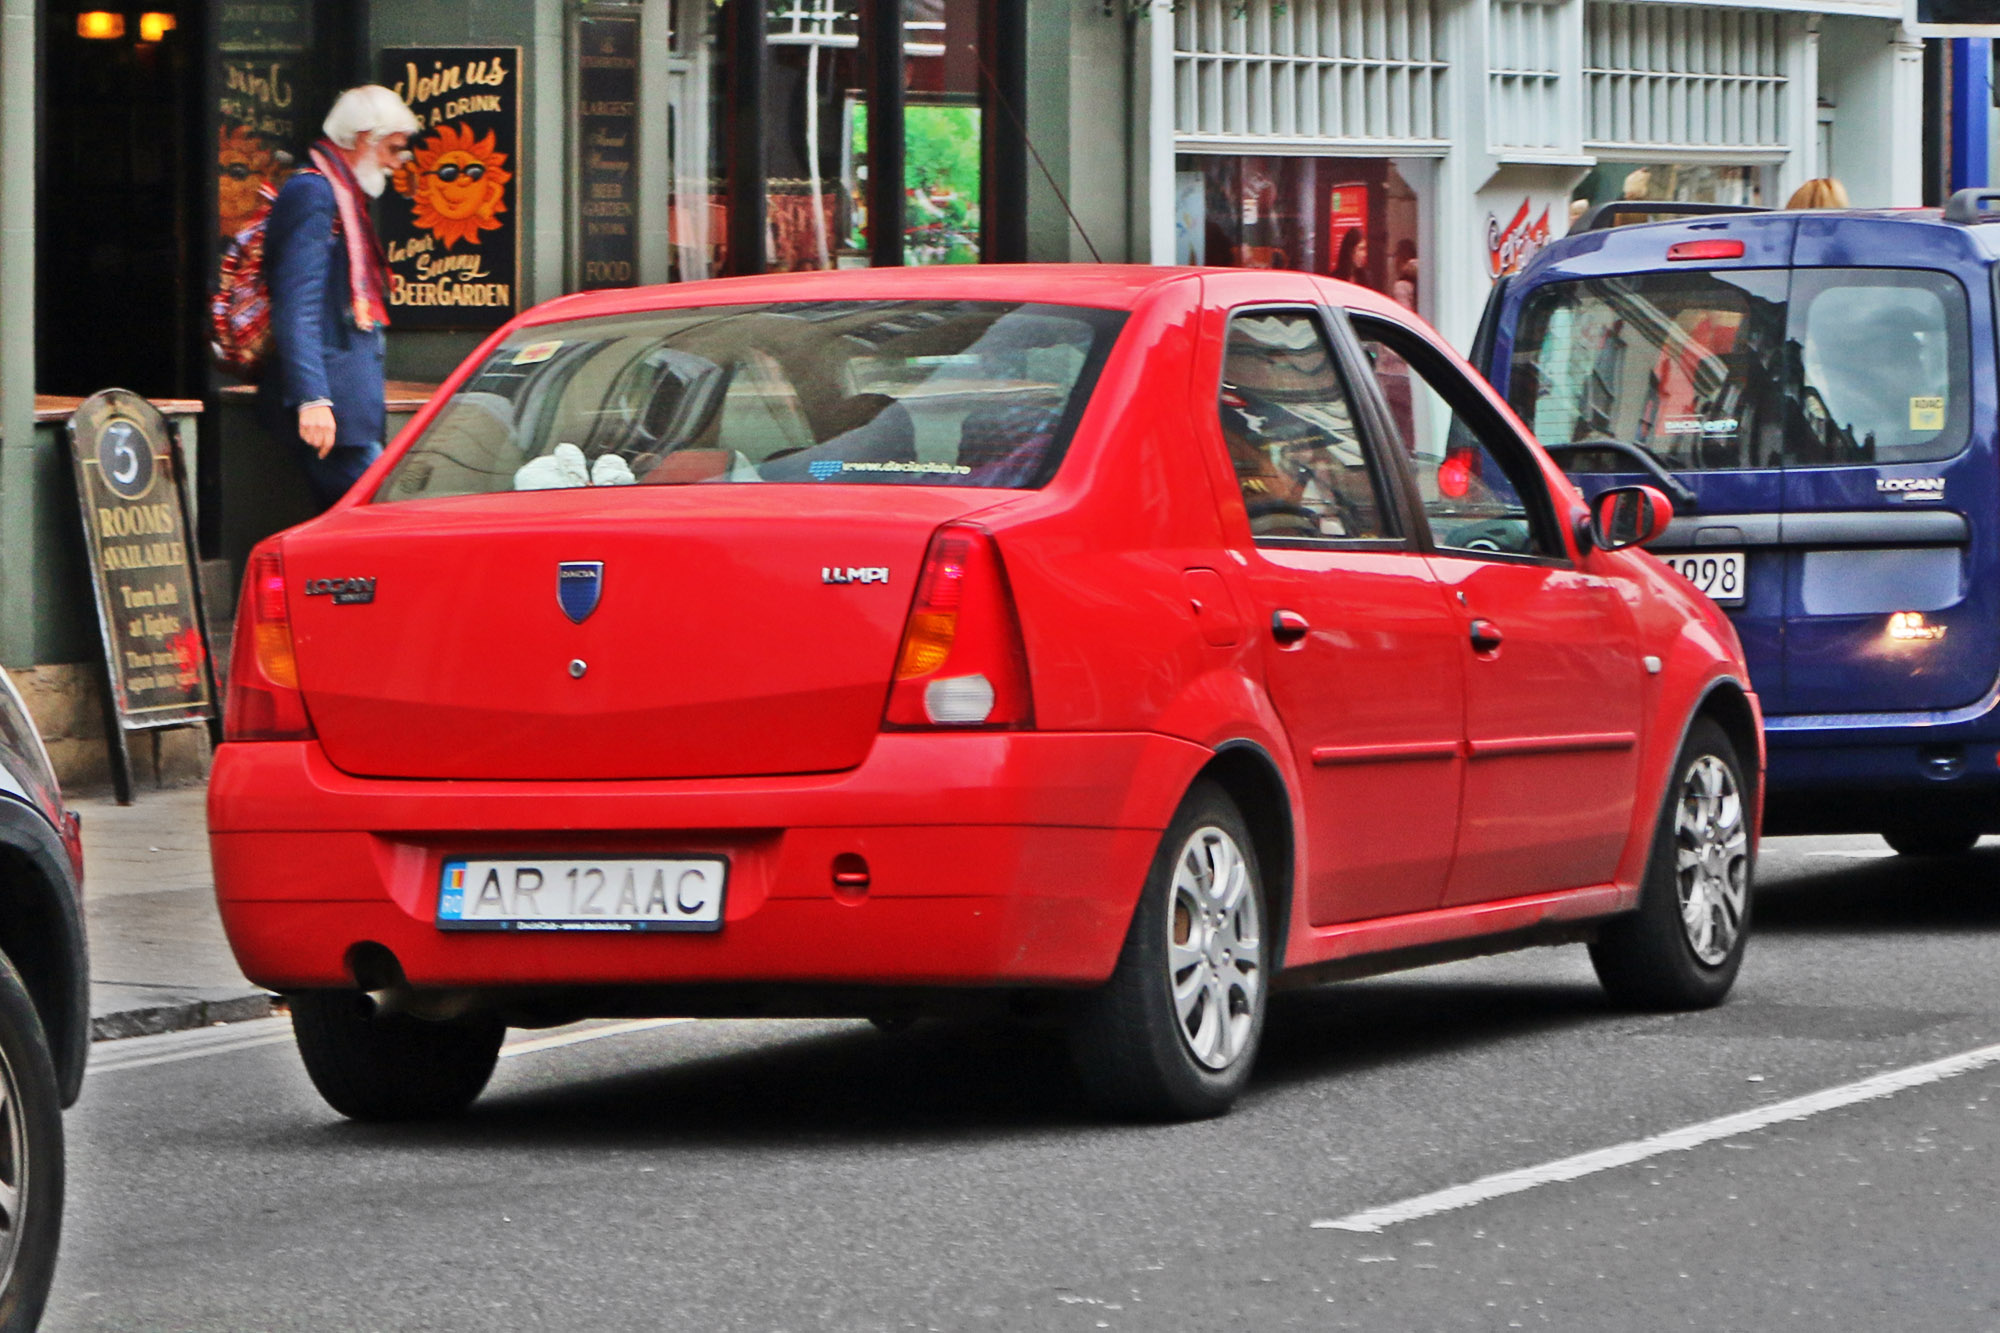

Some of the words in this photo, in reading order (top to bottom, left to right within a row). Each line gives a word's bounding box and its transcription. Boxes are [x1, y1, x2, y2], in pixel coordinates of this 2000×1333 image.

[393, 61, 462, 106] Join
[465, 56, 508, 86] us
[445, 94, 502, 120] DRINK
[416, 253, 490, 281] Sunny
[586, 261, 632, 281] FOOD
[1876, 478, 1945, 492] LOGAN
[98, 503, 174, 538] ROOMS
[103, 541, 185, 571] AVAILABLE
[304, 576, 376, 596] LOGAN
[1668, 558, 1736, 593] 998
[472, 867, 544, 916] AR
[566, 867, 606, 915] 12
[616, 868, 706, 915] AAC
